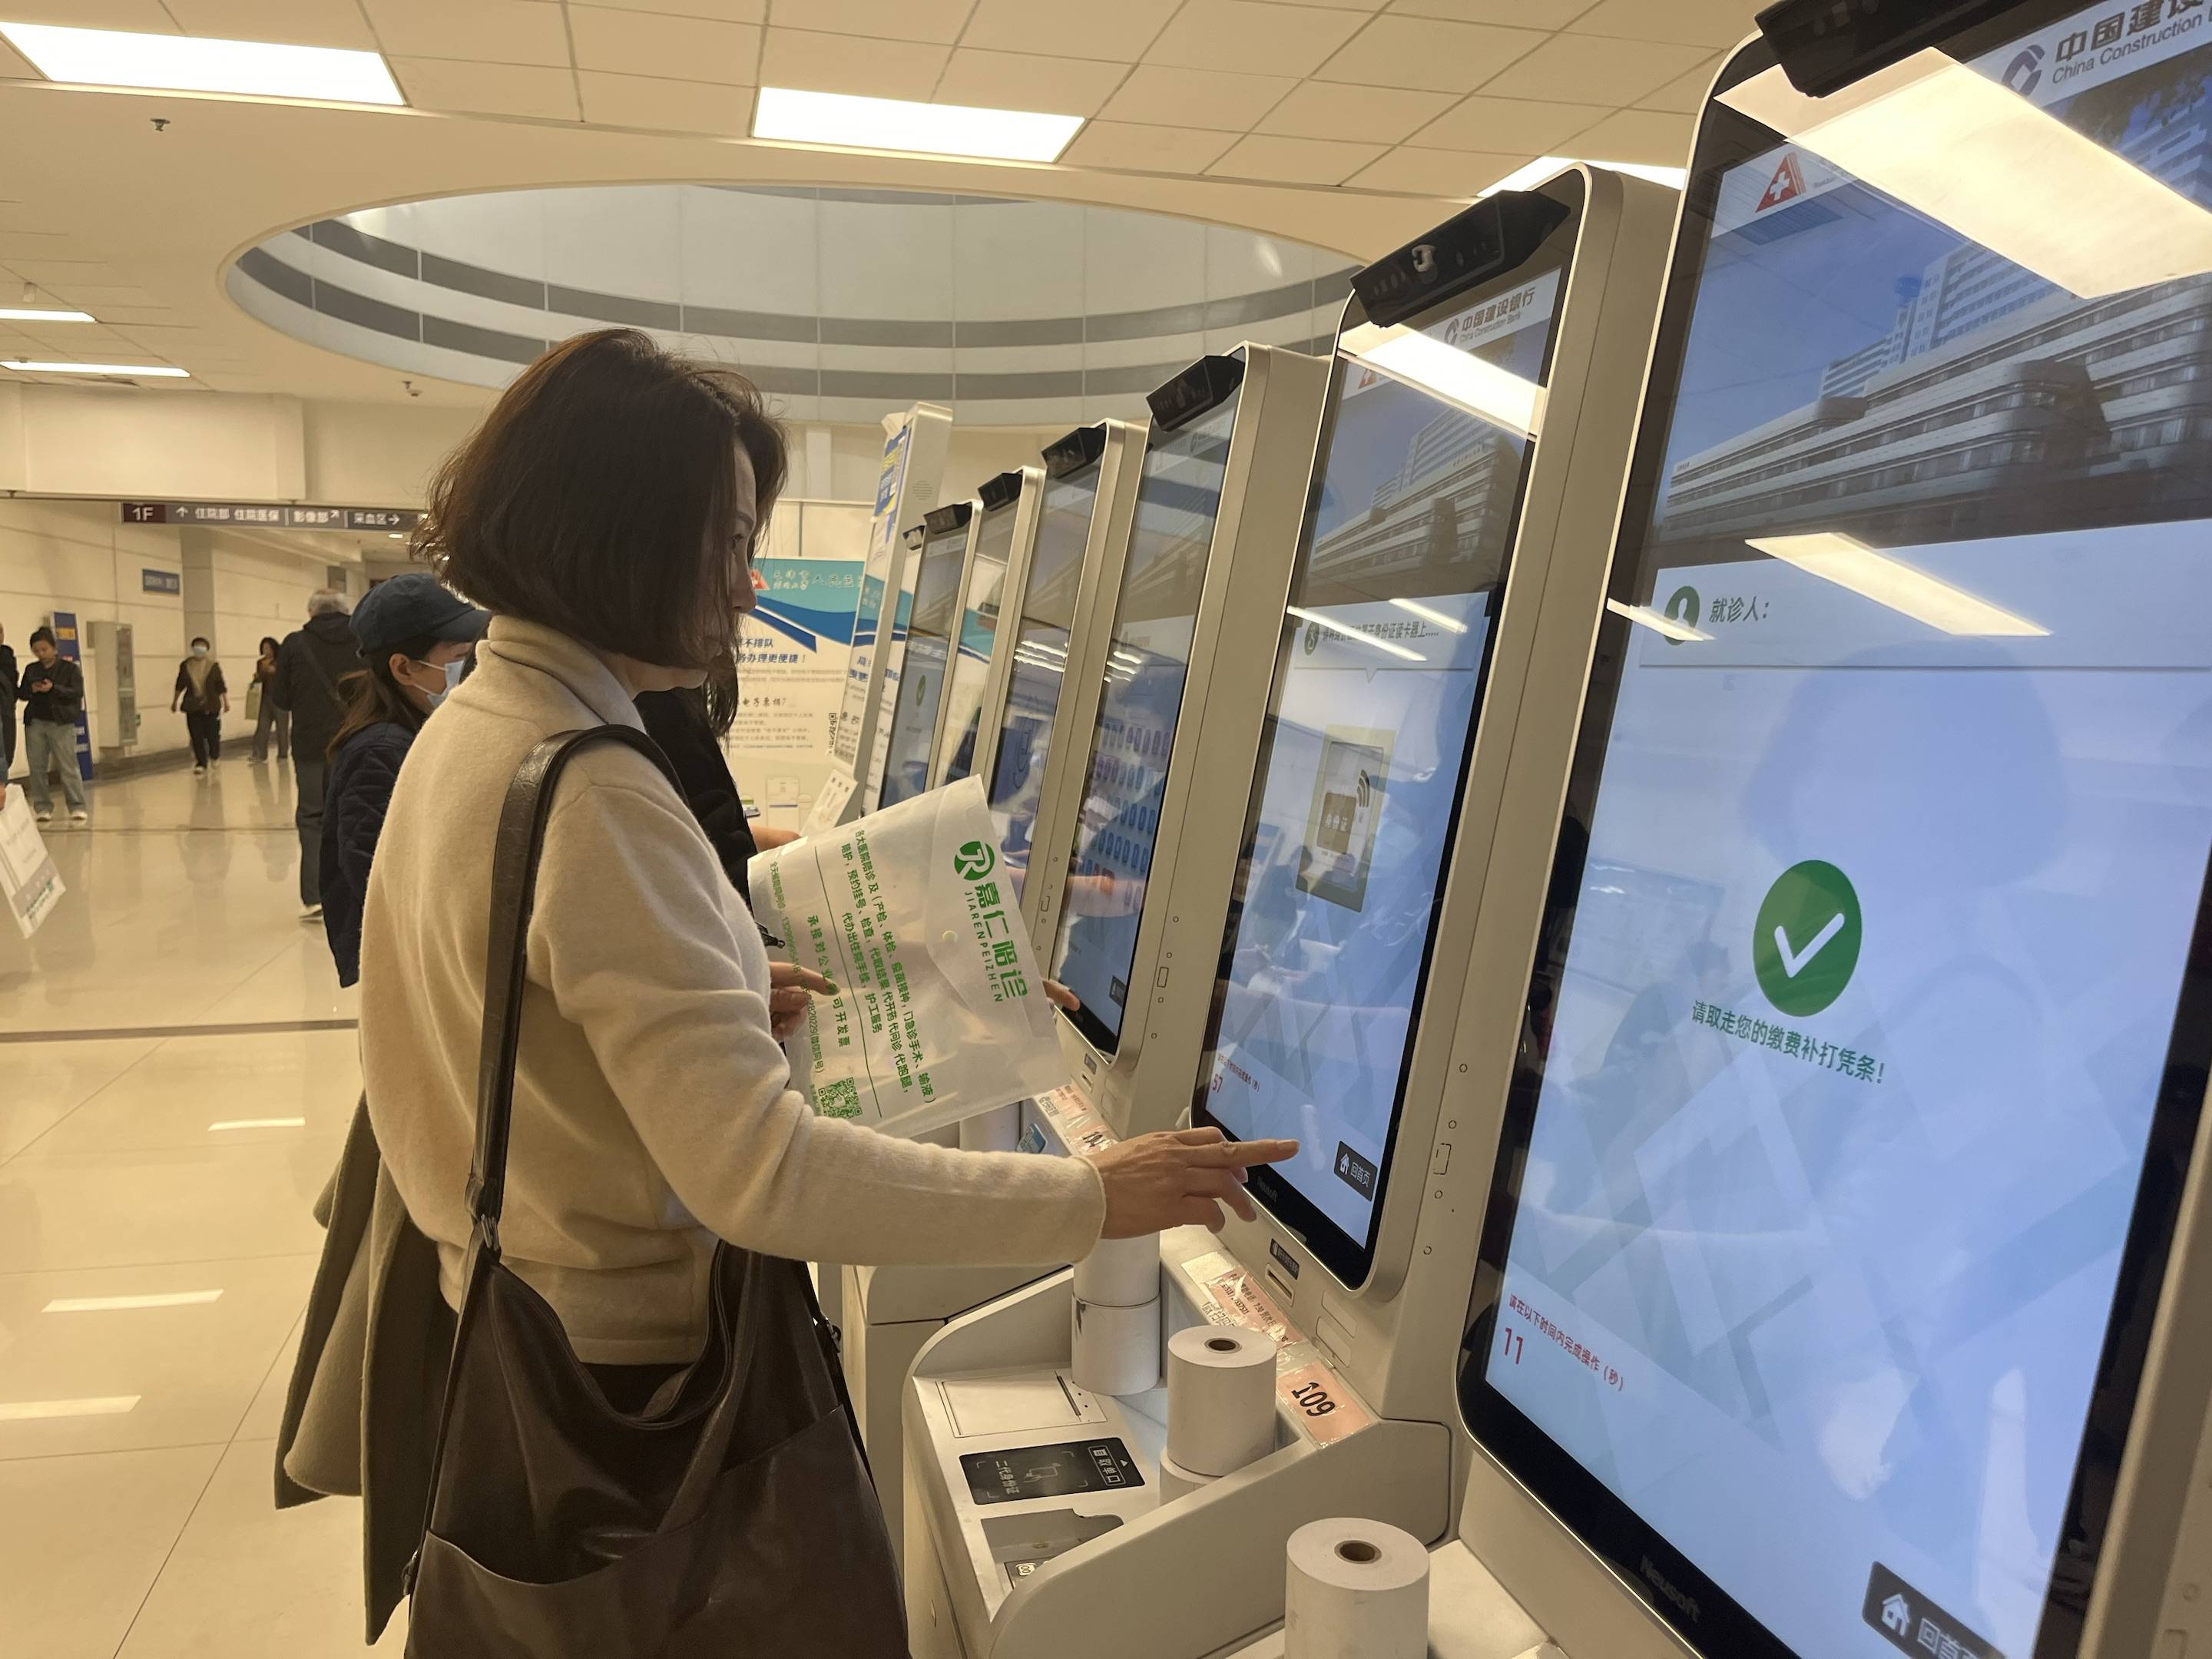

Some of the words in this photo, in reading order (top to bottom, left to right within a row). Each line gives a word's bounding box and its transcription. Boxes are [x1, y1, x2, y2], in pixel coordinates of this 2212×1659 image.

[2052, 59, 2094, 84] China
[2100, 14, 2203, 65] Construction
[1462, 286, 1536, 332] 中国建设银行
[132, 506, 154, 522] 1F
[965, 891, 1003, 1002] JIARENPEIZHEN
[974, 881, 1028, 998] 嘉仁陪诊
[1691, 1000, 1885, 1084] 请取走您的缴费补打凭条！
[1350, 1161, 1371, 1188] 回首页
[1505, 1327, 1524, 1365] 11
[1291, 1382, 1336, 1417] 109
[1917, 1618, 1979, 1659] 回首
